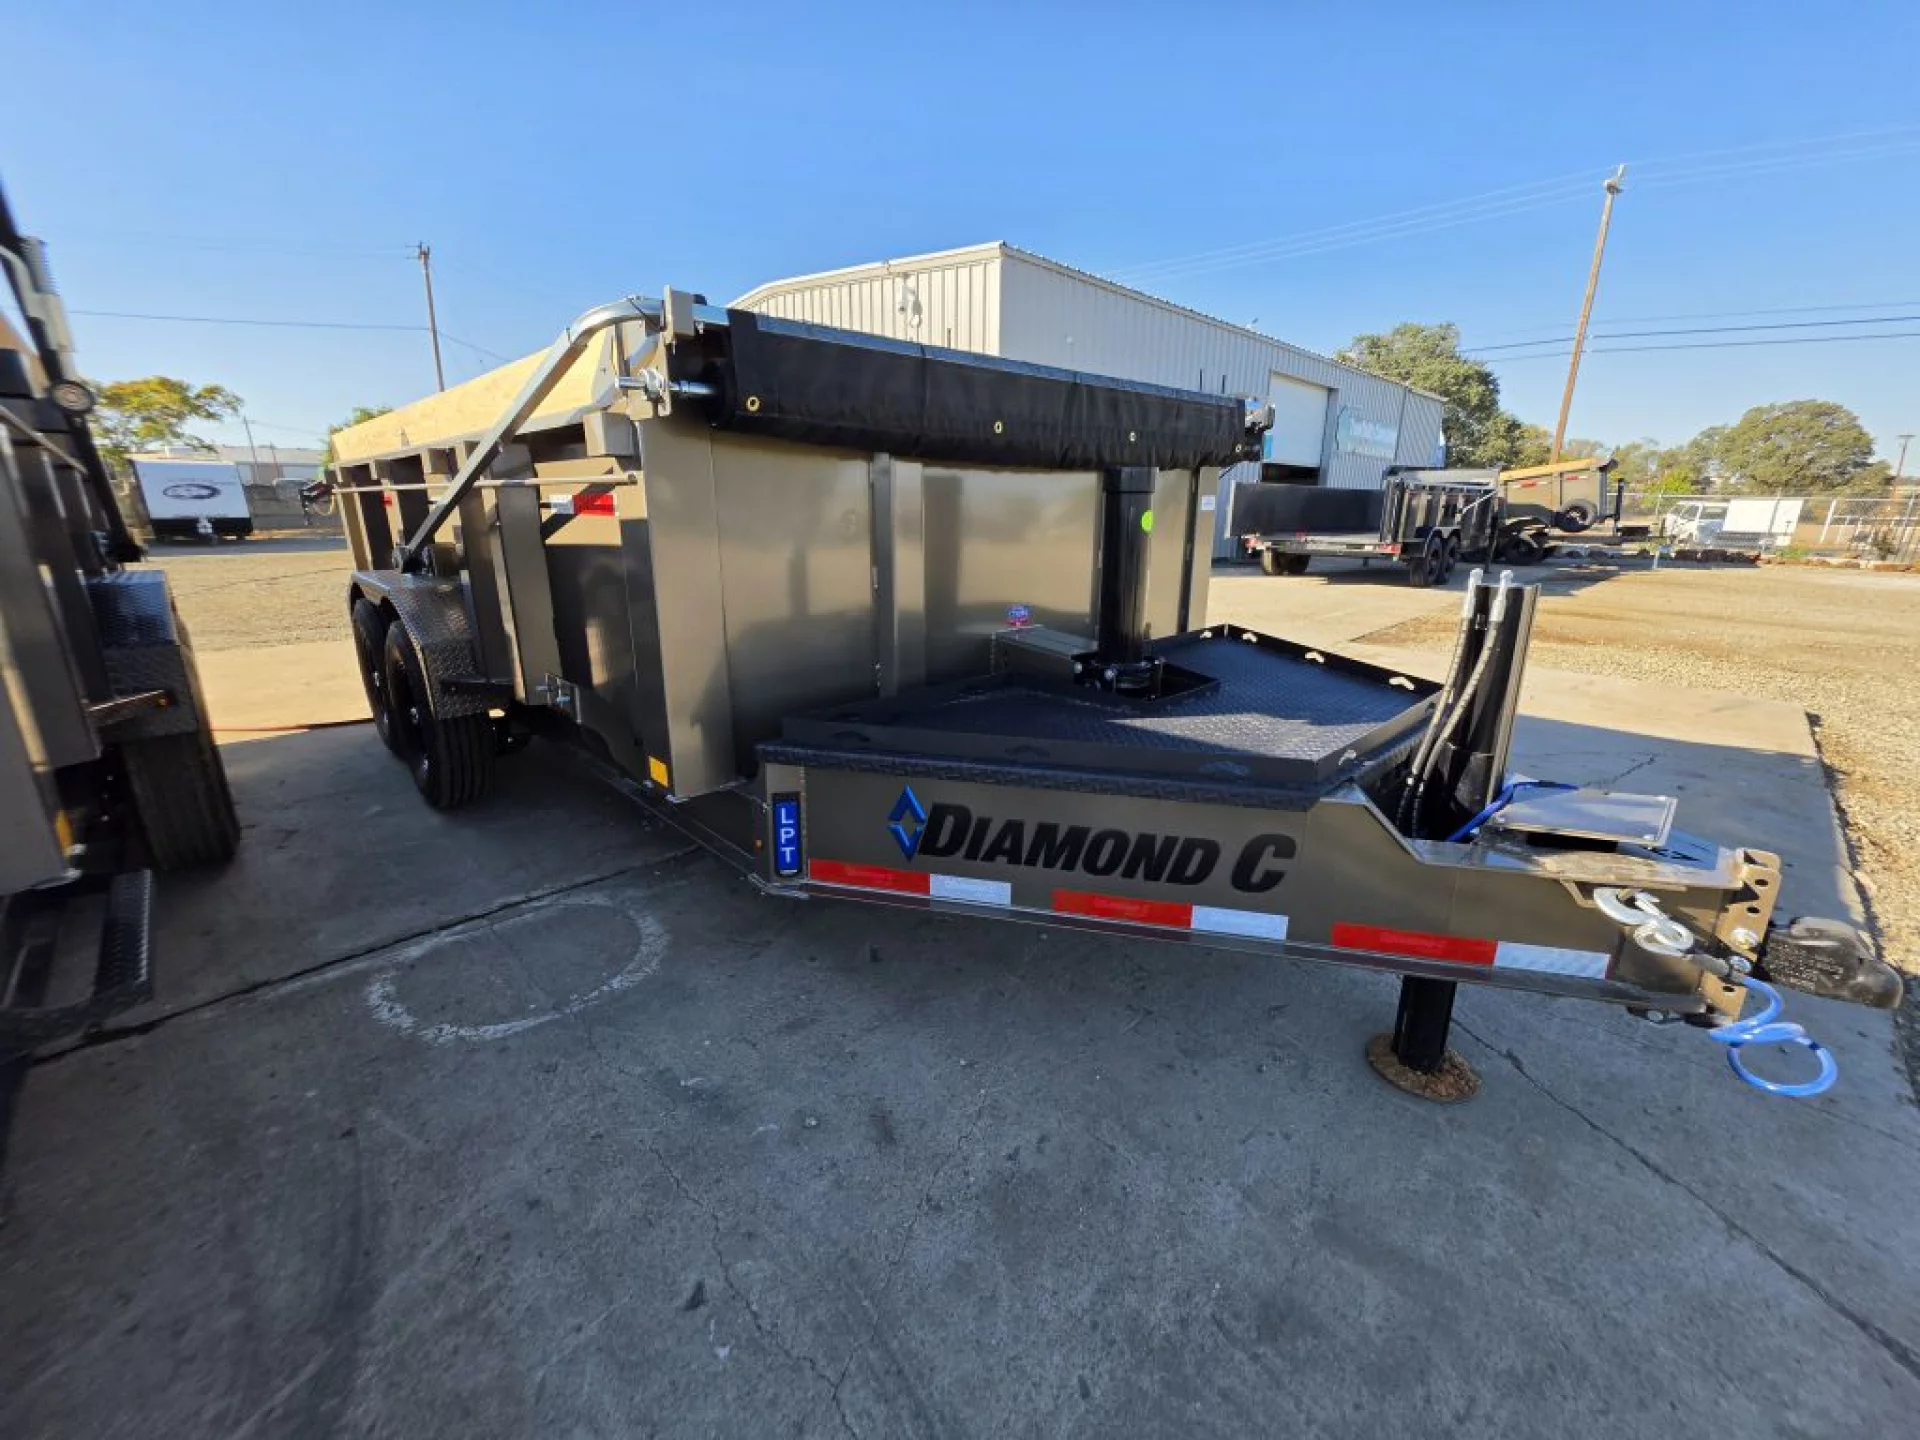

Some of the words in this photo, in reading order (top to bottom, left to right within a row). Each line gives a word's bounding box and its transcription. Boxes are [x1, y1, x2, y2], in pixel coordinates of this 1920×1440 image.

[780, 807, 796, 864] LPT
[918, 802, 1221, 886] DIAMOND
[1230, 833, 1297, 894] C
